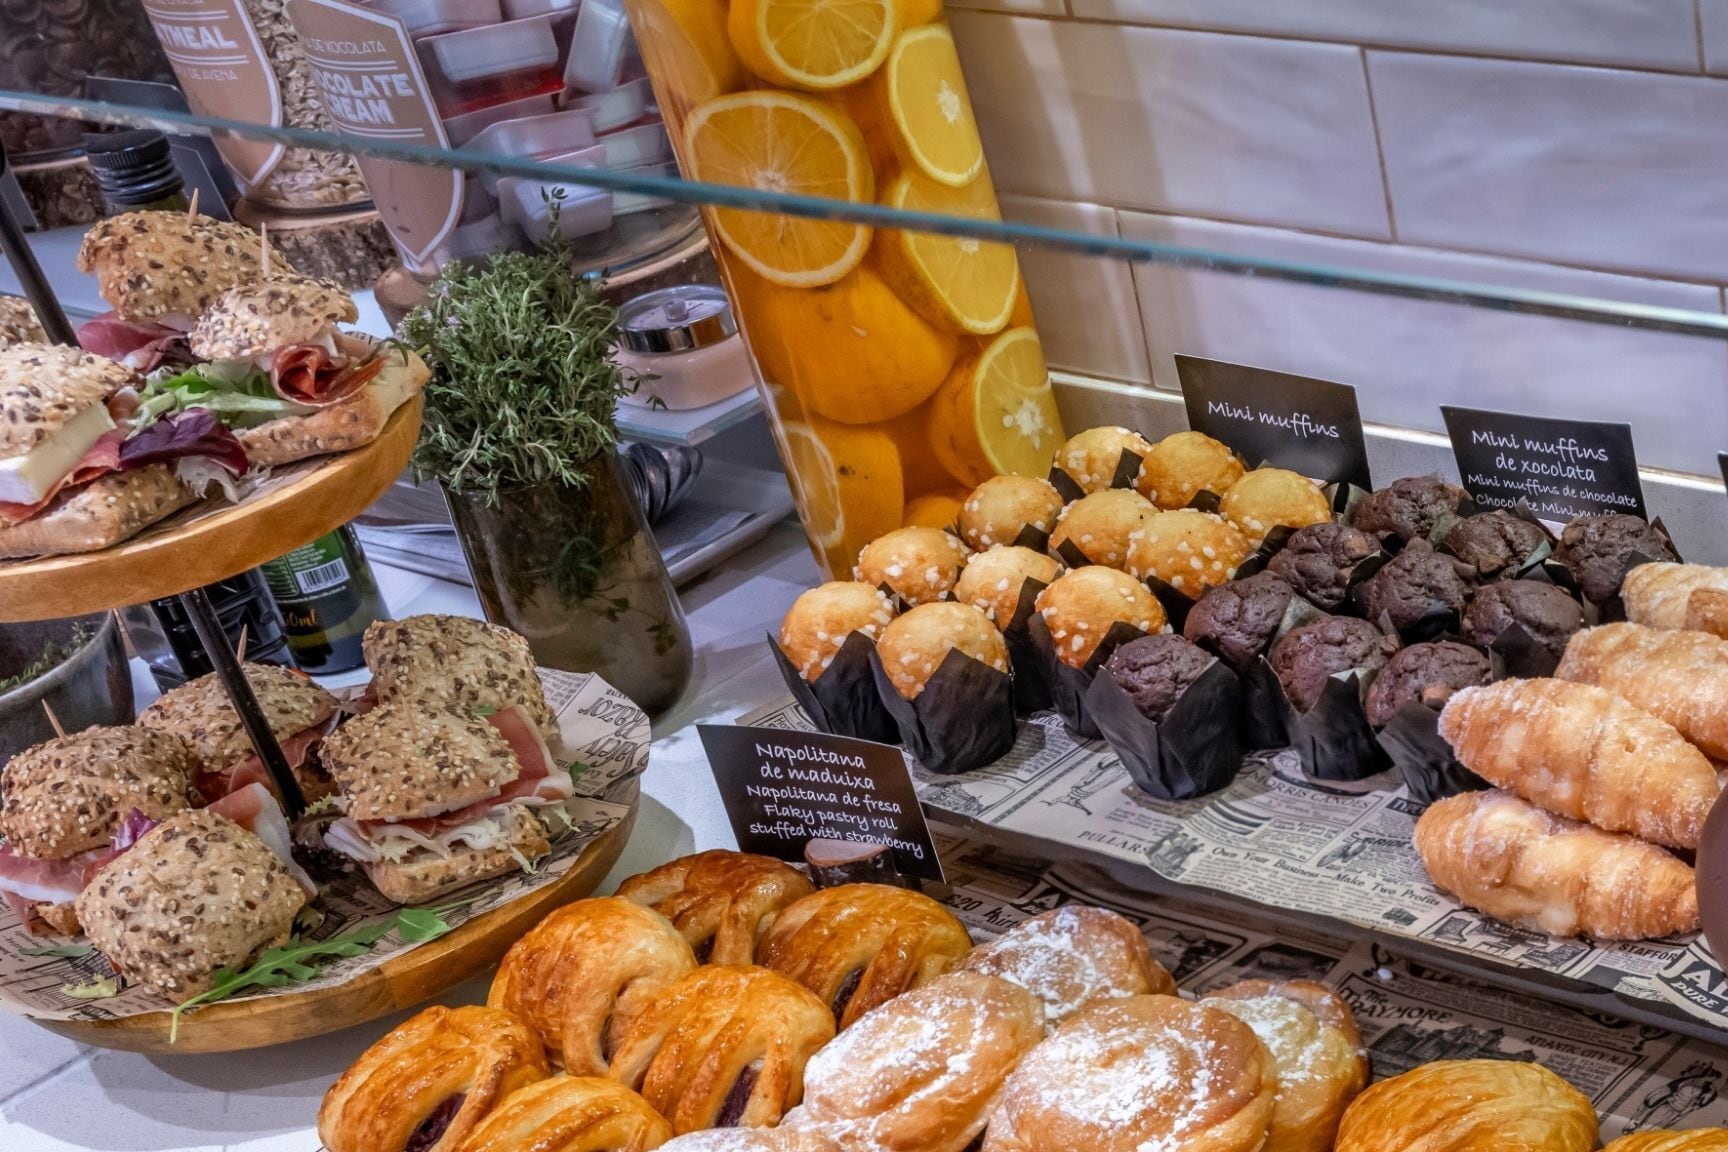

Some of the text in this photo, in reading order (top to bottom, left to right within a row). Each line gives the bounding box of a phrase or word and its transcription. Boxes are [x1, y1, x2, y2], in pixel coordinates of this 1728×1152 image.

[1208, 401, 1340, 439] Mini muffins
[1472, 430, 1609, 464] Mini muffins
[1495, 452, 1597, 483] de xocolata
[1468, 473, 1638, 508] Mini muffins de chocolate
[755, 742, 866, 769] Napolitana
[760, 762, 876, 791] de maduixa
[746, 784, 903, 814] Napolitana de fresa
[764, 805, 898, 831] Flaky pastry roll
[750, 821, 925, 860] stuffed with strawberry
[1371, 881, 1397, 896] Two
[1399, 888, 1441, 908] Profits
